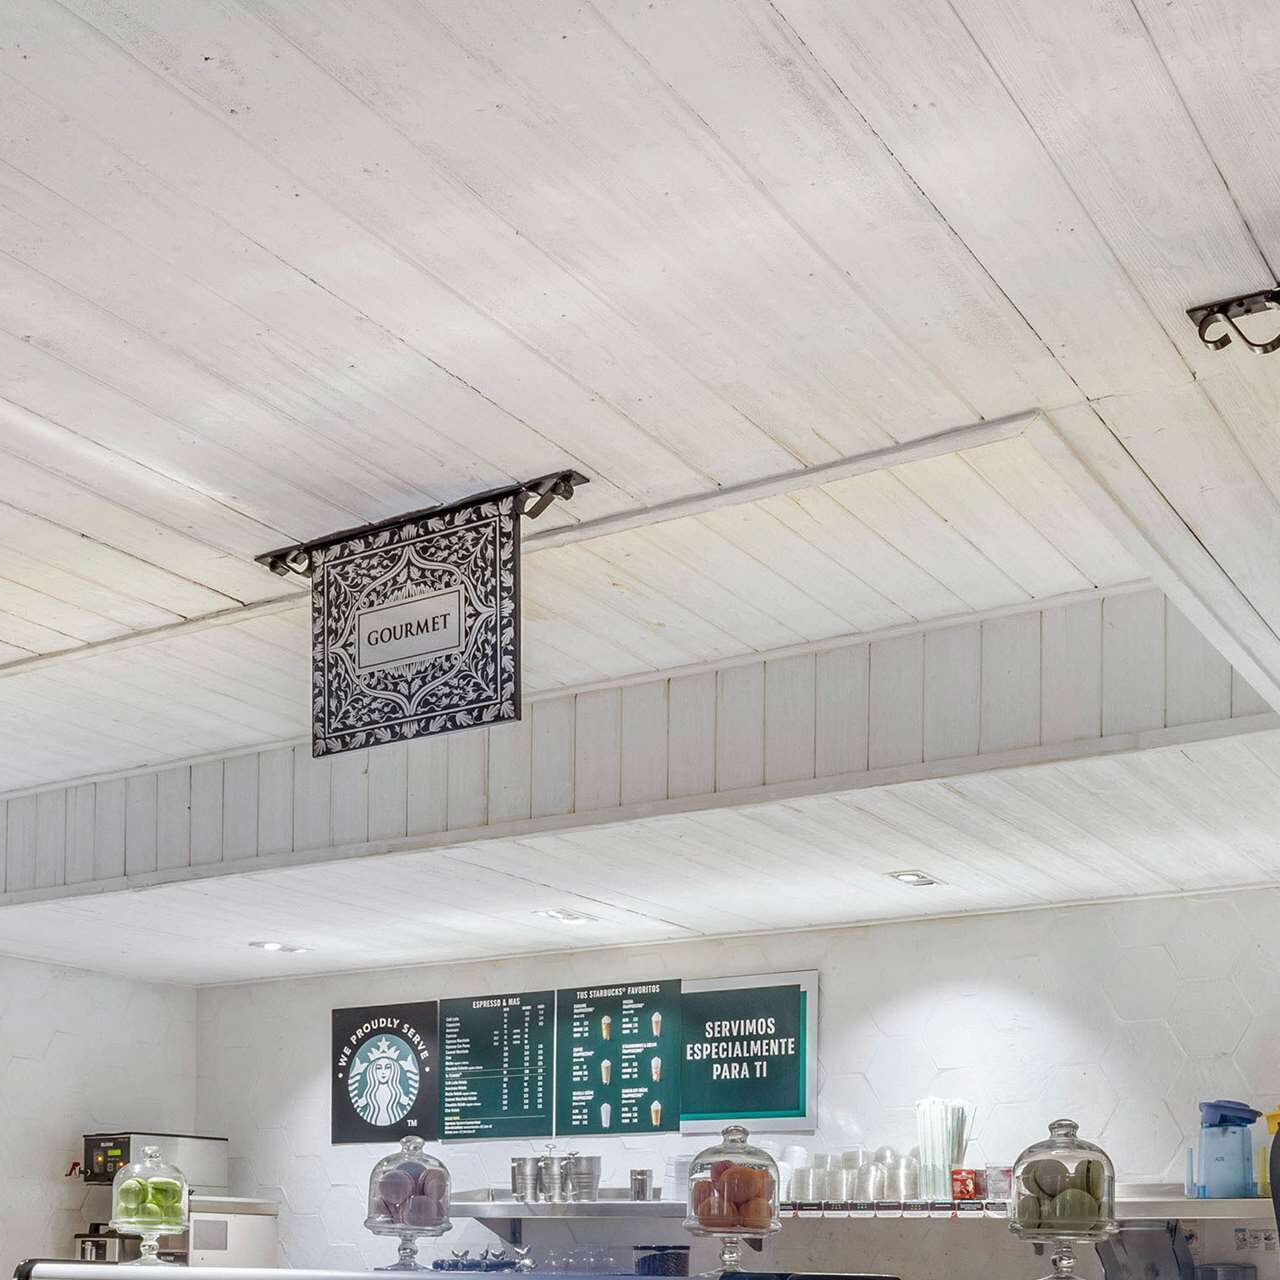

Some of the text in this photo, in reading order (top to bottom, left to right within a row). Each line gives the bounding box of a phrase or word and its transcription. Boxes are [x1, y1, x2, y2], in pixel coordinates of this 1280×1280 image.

[367, 613, 451, 646] GOURMET
[577, 991, 588, 1000] TUS
[627, 985, 660, 995] FAVORITOS
[472, 999, 501, 1009] ESPRESSO
[705, 1017, 775, 1038] SERVIMOS
[338, 1046, 352, 1067] WE
[349, 1018, 400, 1045] PROUDLY
[401, 1023, 429, 1060] SERVE
[686, 1038, 795, 1060] ESPECIALMENTE
[713, 1061, 767, 1080] PARA TI
[407, 1119, 417, 1127] TM
